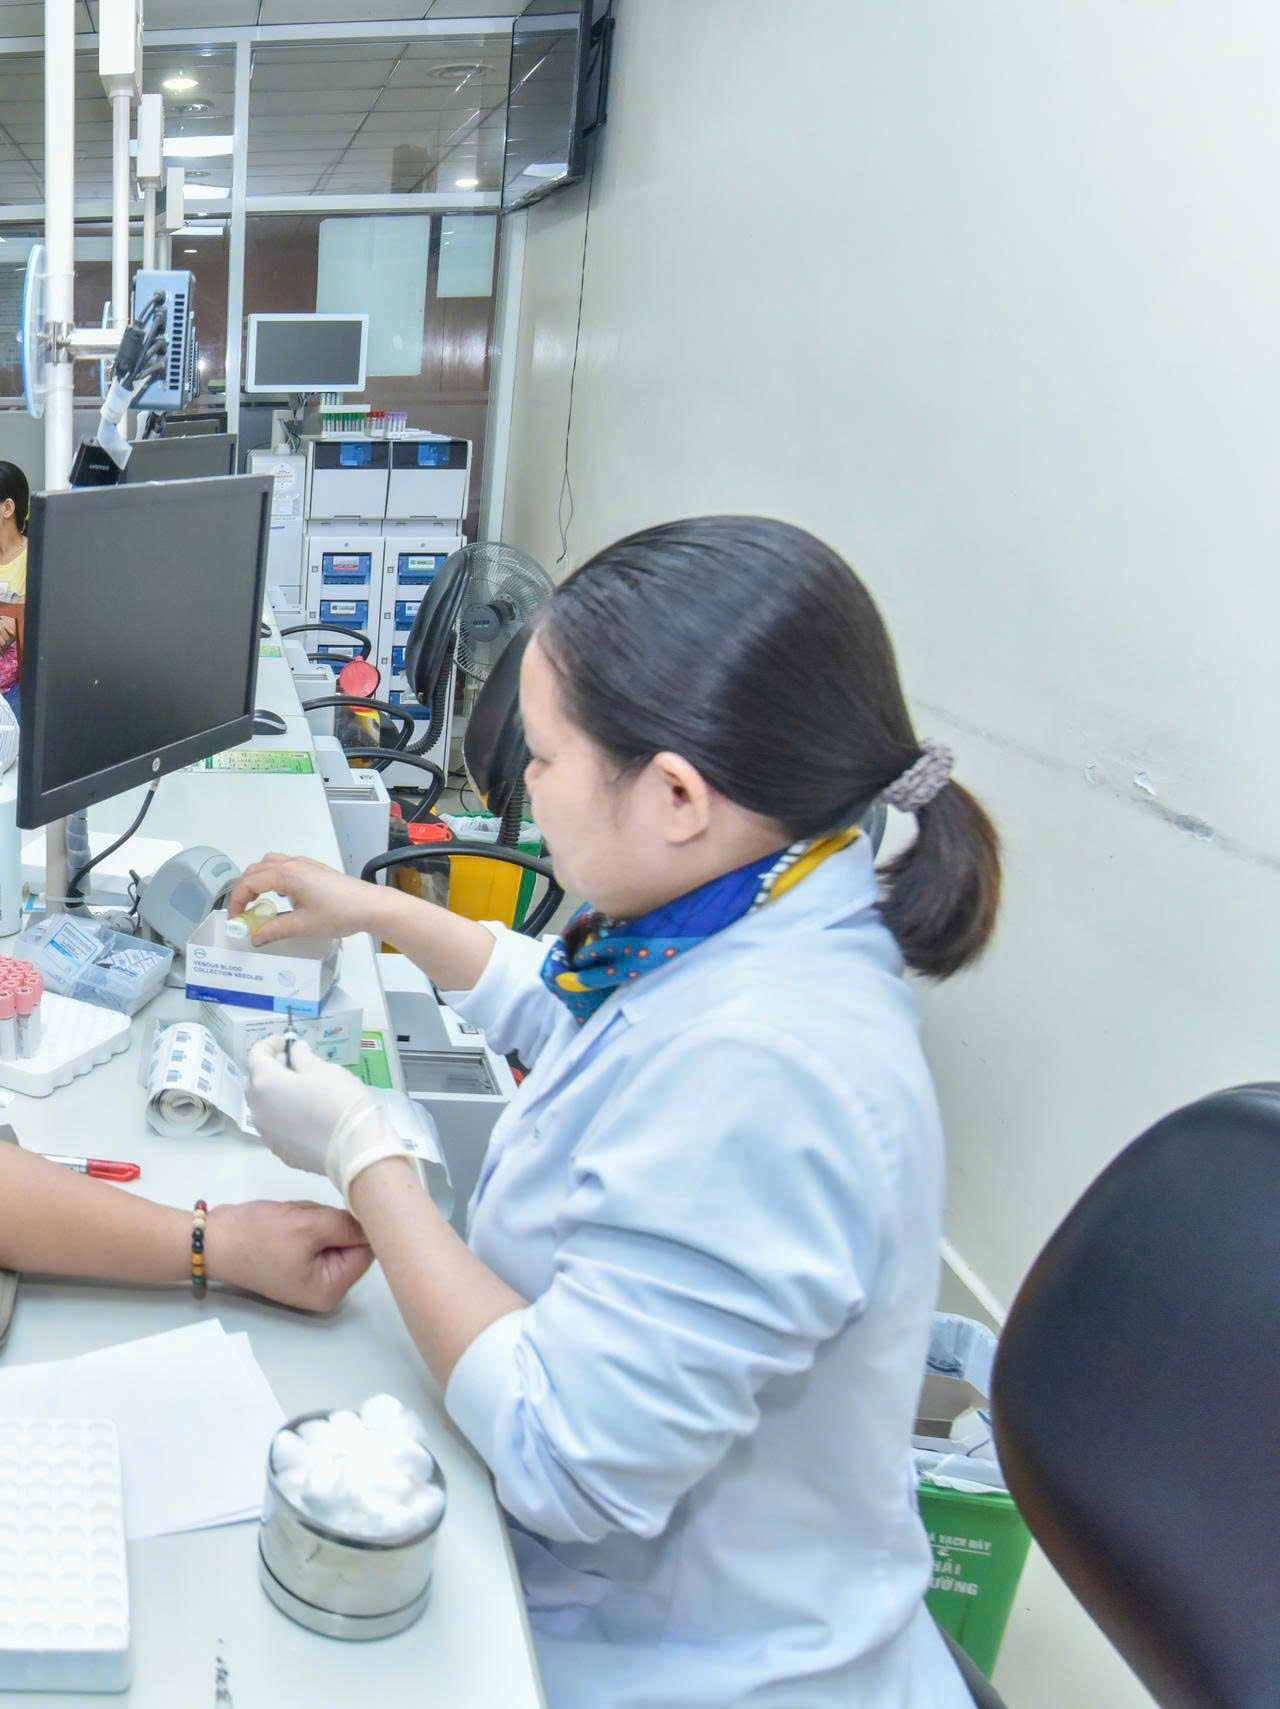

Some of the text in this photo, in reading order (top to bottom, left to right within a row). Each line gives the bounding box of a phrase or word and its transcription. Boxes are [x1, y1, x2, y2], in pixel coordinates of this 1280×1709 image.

[193, 960, 243, 972] VENOUS BLOOD
[193, 966, 234, 977] COLLECTION
